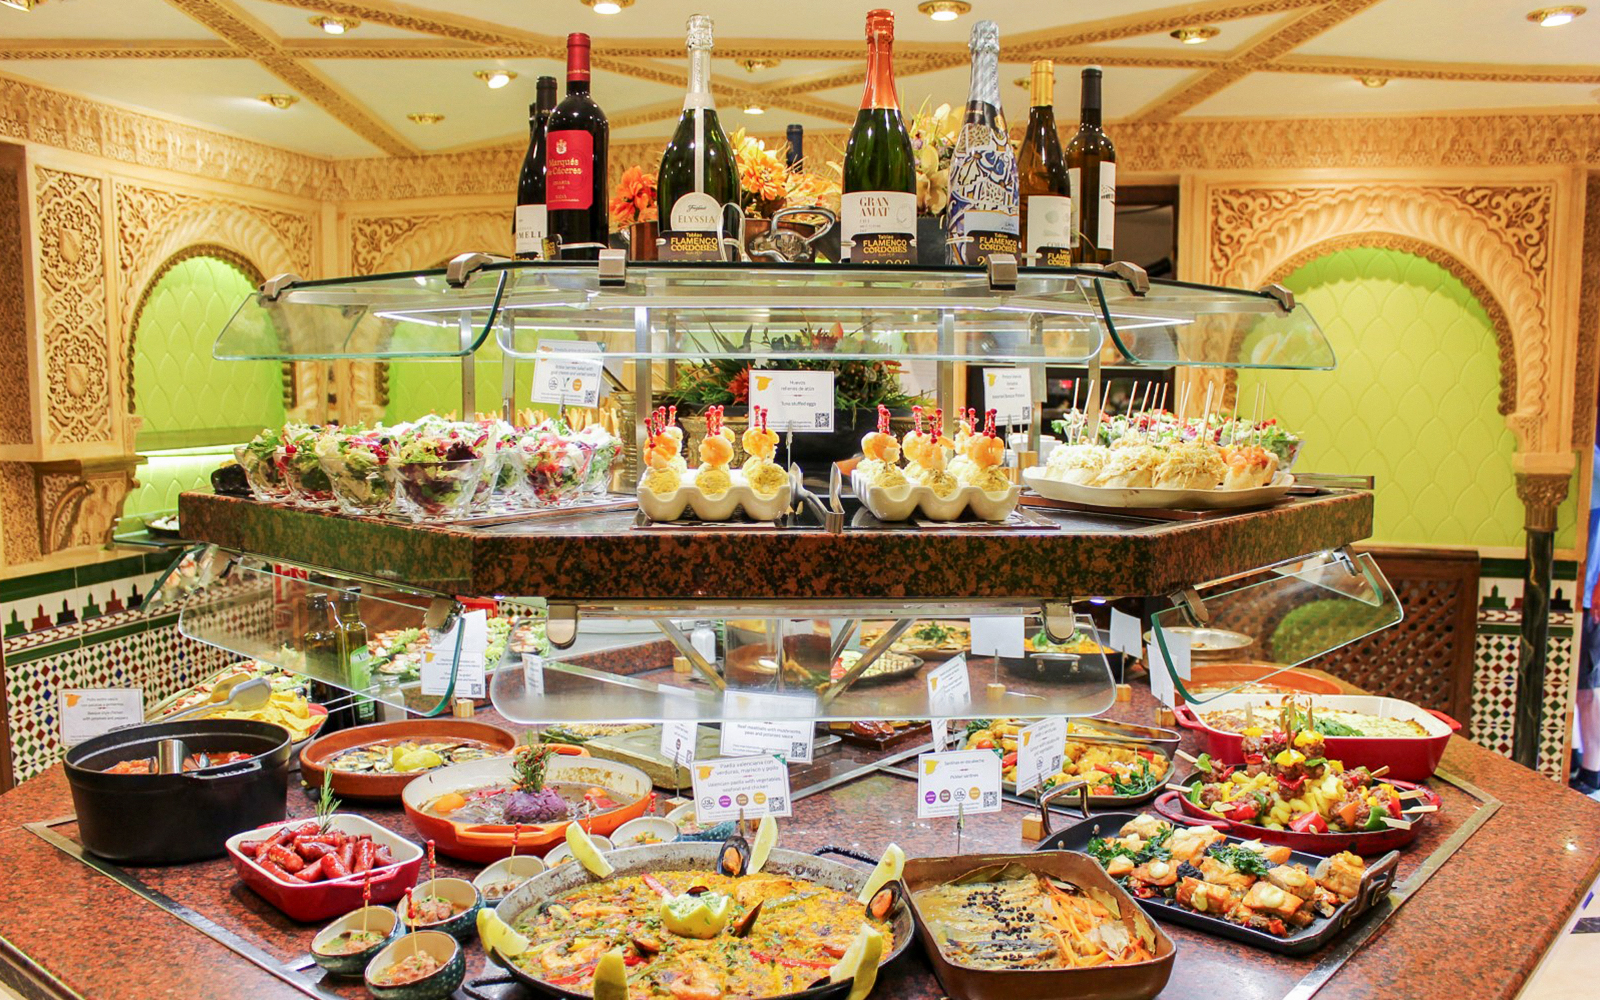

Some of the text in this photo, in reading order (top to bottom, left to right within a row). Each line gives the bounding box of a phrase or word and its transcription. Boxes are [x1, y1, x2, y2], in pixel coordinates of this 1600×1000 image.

[859, 196, 889, 207] GRAN
[861, 207, 889, 217] AMAT
[678, 214, 716, 224] ELYSSIA
[670, 237, 718, 245] FLAMENCO
[863, 239, 907, 247] FLAMENCO
[979, 236, 1017, 247] FLAMENCO
